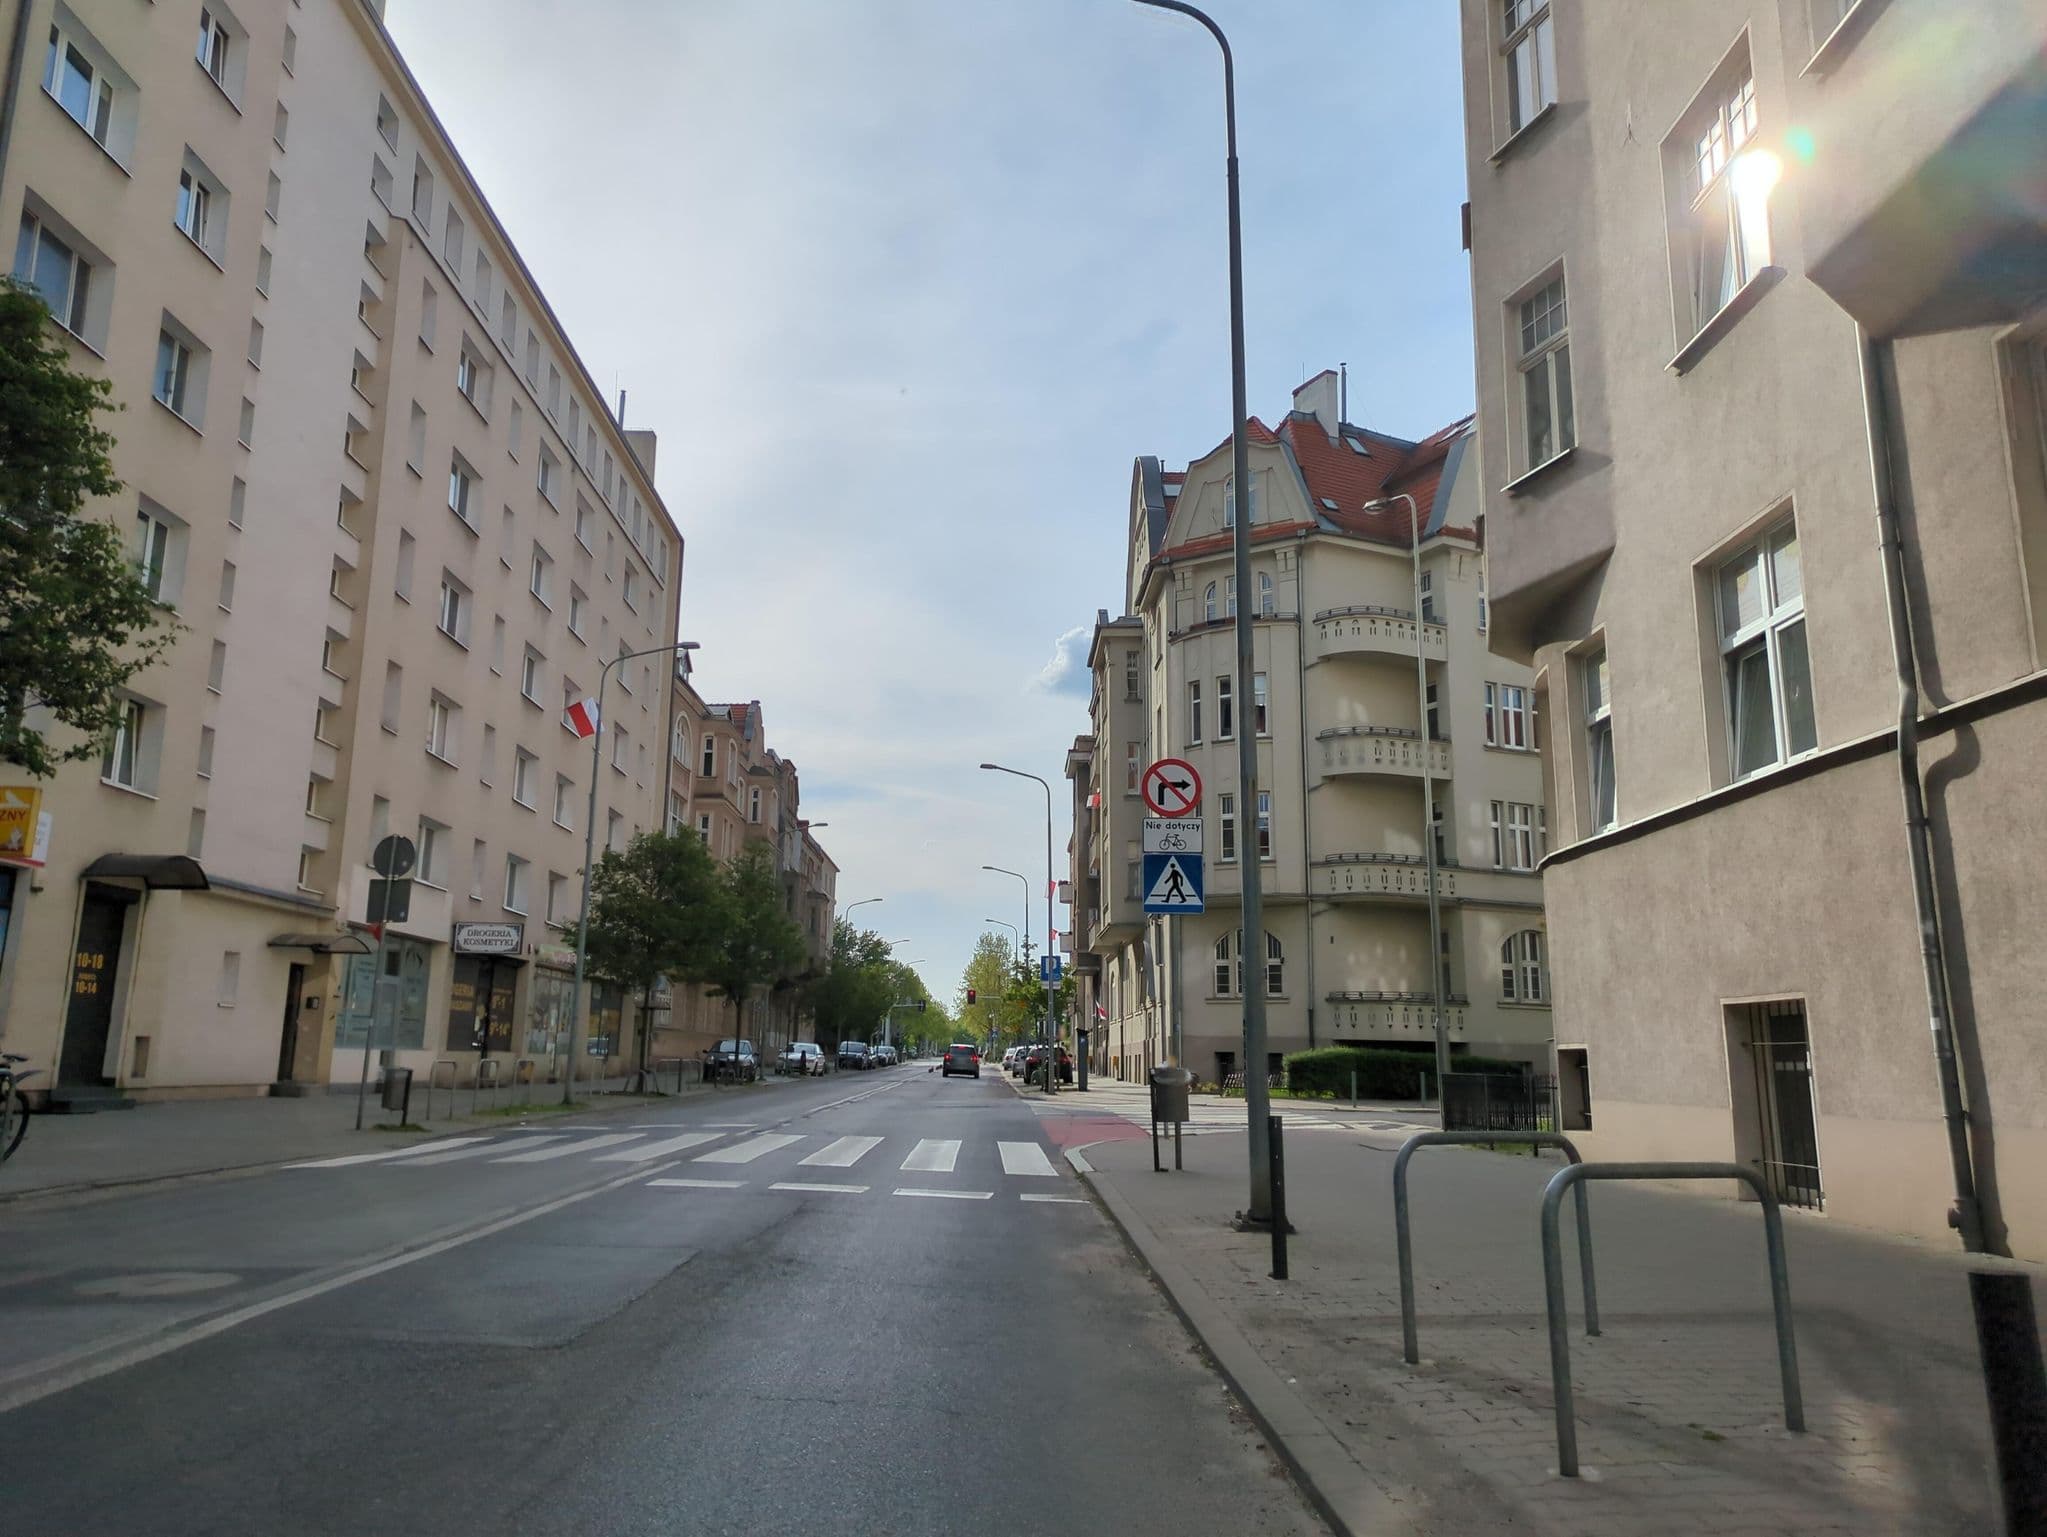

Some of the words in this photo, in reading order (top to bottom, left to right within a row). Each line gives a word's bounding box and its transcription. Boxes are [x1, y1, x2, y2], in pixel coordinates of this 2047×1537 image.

[1145, 821, 1161, 830] Nie
[1165, 821, 1201, 832] dotyczy
[467, 928, 512, 938] DROGERIA
[463, 937, 514, 947] KOSMETYKI
